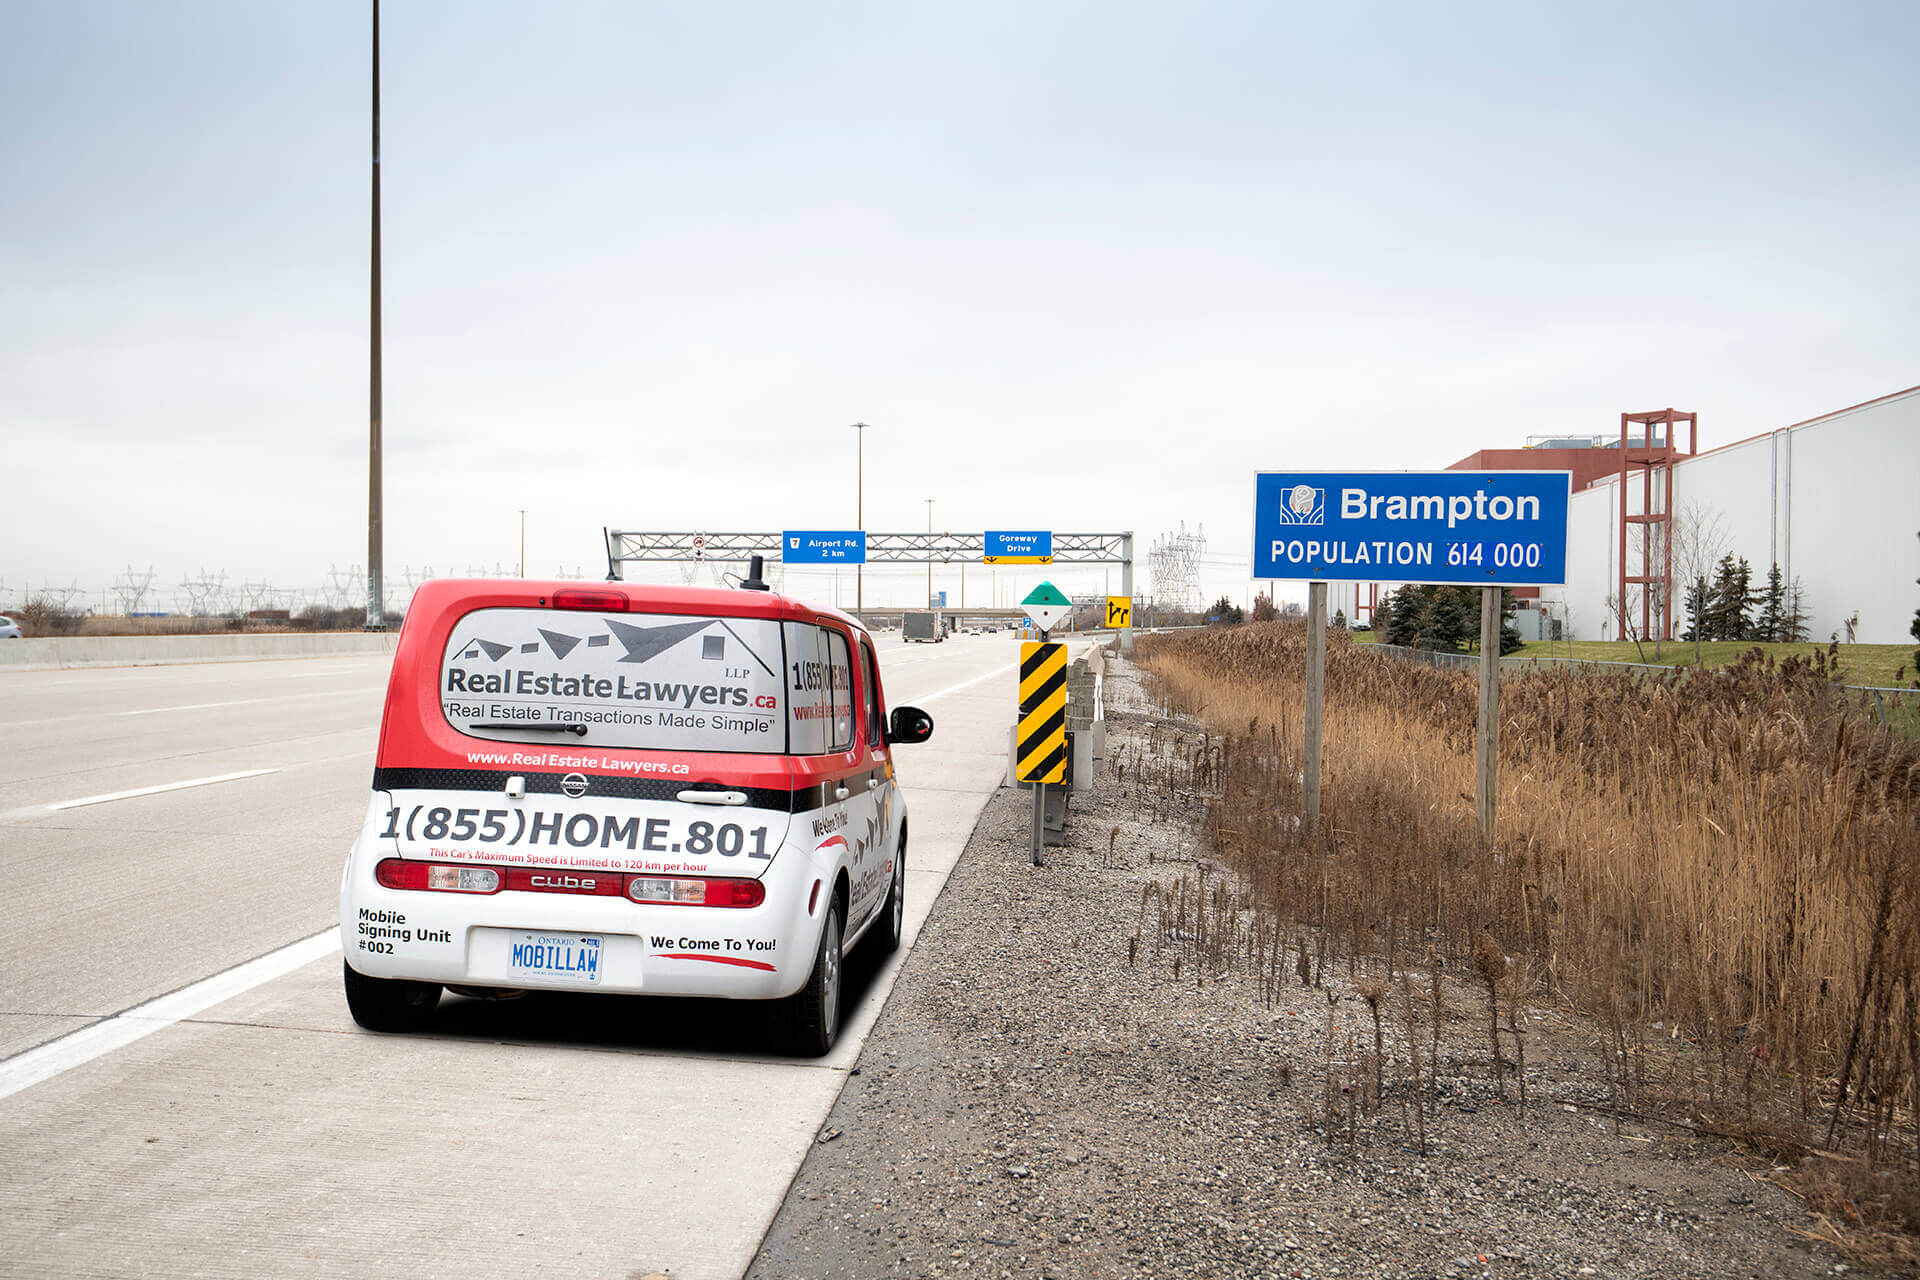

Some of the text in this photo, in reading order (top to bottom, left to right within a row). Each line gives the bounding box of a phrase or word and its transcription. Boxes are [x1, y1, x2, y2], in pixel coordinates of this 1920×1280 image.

[1340, 488, 1540, 528] Brampton
[808, 540, 841, 548] Airport
[999, 534, 1037, 543] Goreway
[1271, 540, 1540, 567] POPULATION 614 000
[725, 667, 750, 679] LLP
[490, 704, 541, 720] Estate
[547, 706, 652, 725] Transactions
[658, 712, 706, 728] Made
[429, 848, 448, 857] This
[474, 850, 524, 863] Maximum
[526, 853, 557, 865] Speed
[560, 855, 568, 865] is
[570, 856, 608, 867] Limited
[611, 859, 621, 868] to
[625, 860, 643, 869] 120
[645, 860, 661, 870] km
[663, 863, 681, 872] per
[683, 862, 708, 871] hour
[531, 875, 596, 890] cube
[358, 922, 451, 943] Signing Unit
[359, 940, 394, 955] #002
[538, 936, 575, 946] ONTARIO
[651, 935, 777, 951] We Come To You!
[512, 943, 599, 972] MOBILLAW
